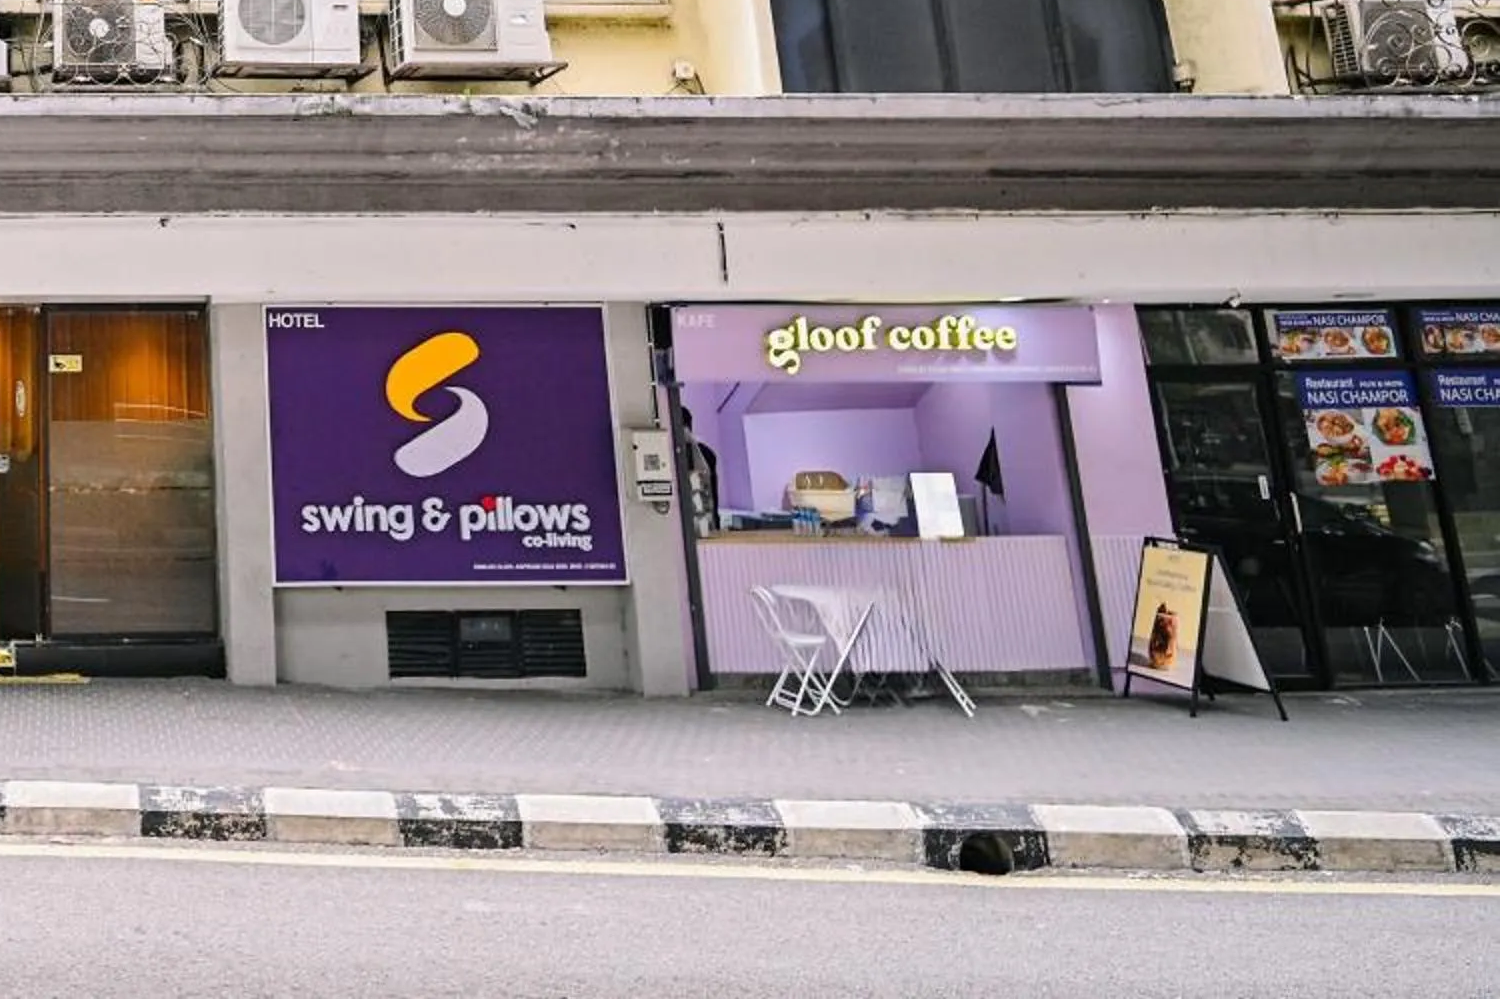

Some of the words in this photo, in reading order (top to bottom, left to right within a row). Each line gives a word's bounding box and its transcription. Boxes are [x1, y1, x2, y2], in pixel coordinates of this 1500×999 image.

[269, 313, 325, 328] HOTEL
[766, 315, 882, 375] gloof
[888, 314, 1017, 352] coffee
[1307, 389, 1338, 405] NASI
[1341, 388, 1409, 404] CHAMPOR
[1439, 387, 1473, 402] NASI
[301, 495, 414, 541] swing
[421, 497, 451, 532] &
[460, 495, 591, 541] pillows
[521, 533, 594, 552] co-living
